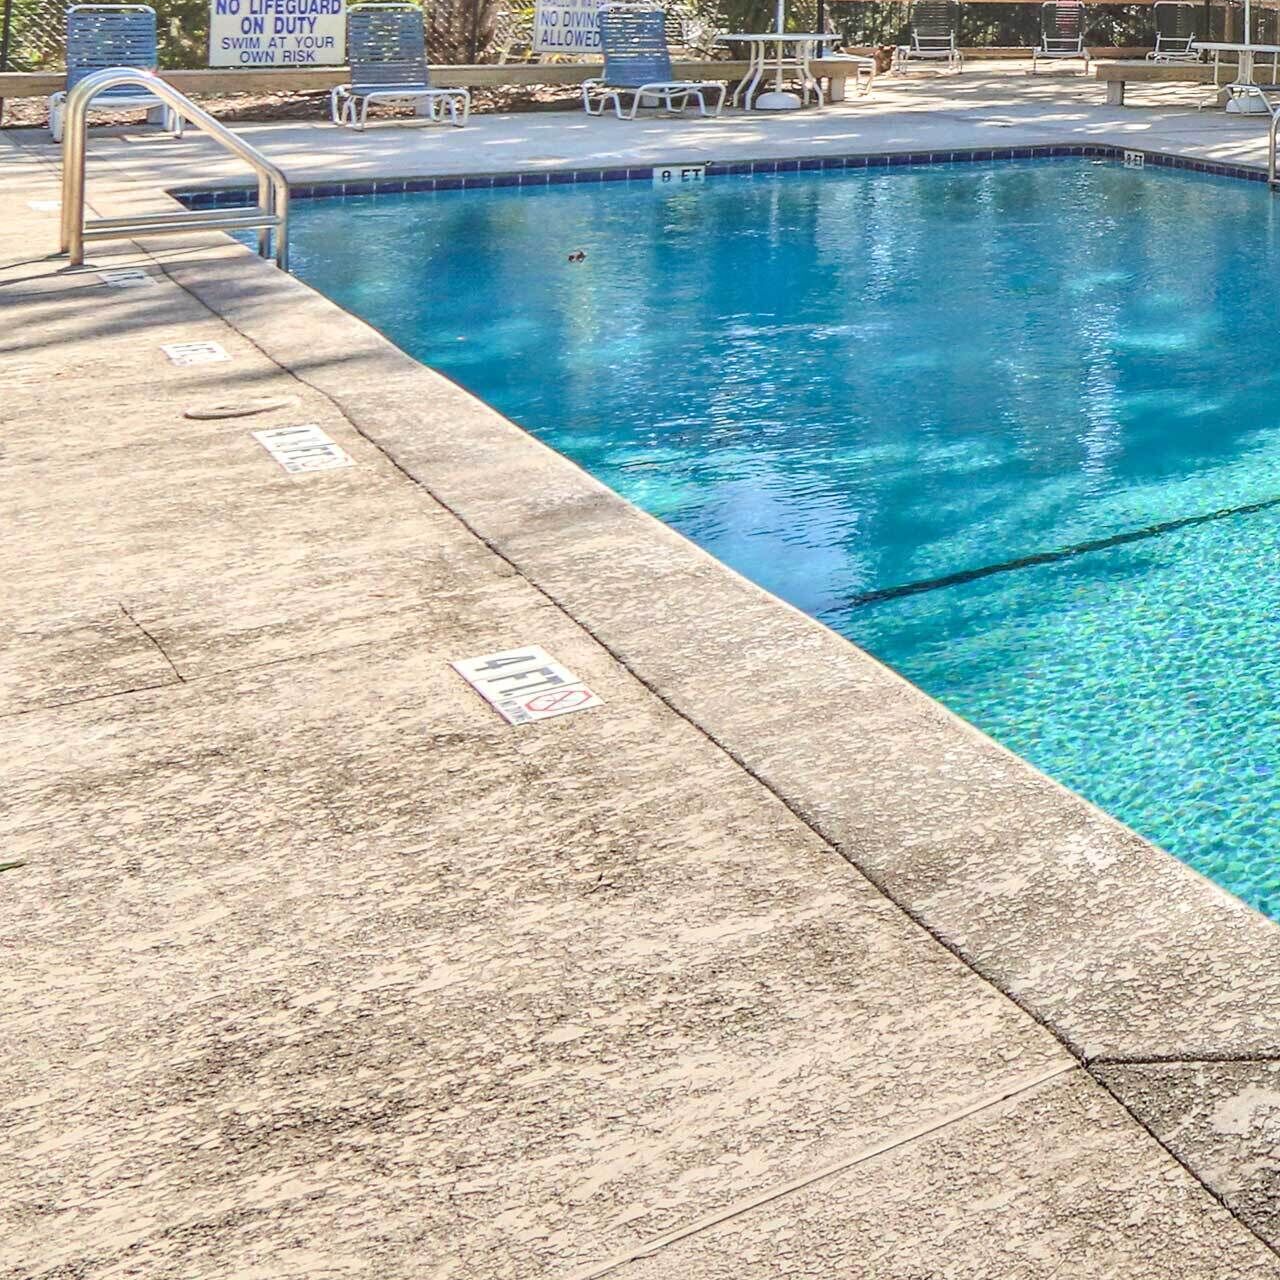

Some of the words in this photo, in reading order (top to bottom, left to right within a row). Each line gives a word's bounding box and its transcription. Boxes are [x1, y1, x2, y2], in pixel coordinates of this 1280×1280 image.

[241, 17, 264, 34] ON
[274, 17, 318, 34] DUTY
[541, 10, 558, 27] NO
[222, 37, 260, 49] SWIM
[268, 37, 287, 48] AT
[295, 36, 335, 49] YOUR
[541, 29, 601, 47] ALLOWED
[240, 51, 275, 63] OWN
[282, 50, 316, 63] RISK
[475, 655, 537, 671] 4
[487, 667, 566, 696] FT.
